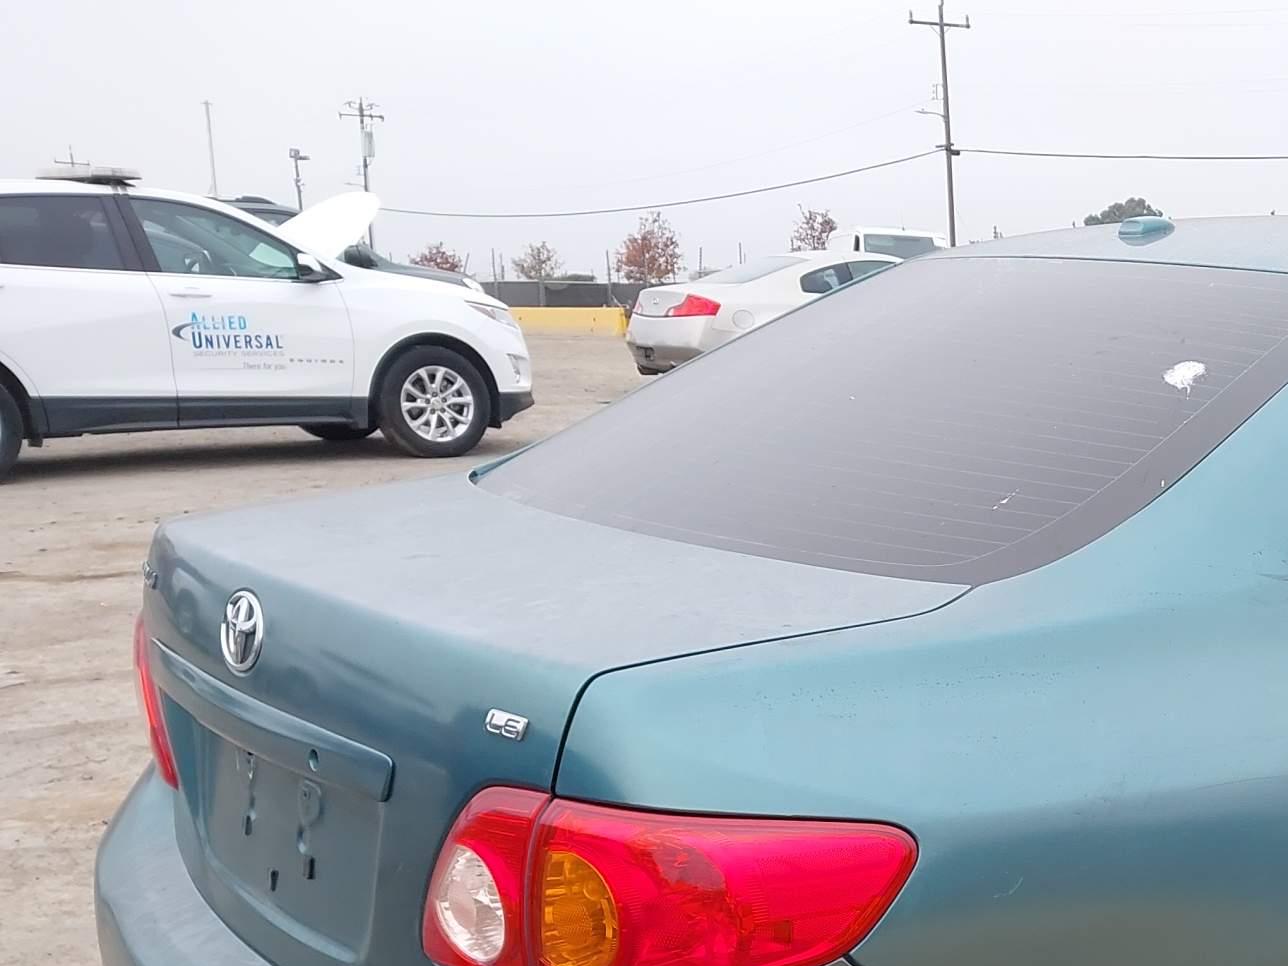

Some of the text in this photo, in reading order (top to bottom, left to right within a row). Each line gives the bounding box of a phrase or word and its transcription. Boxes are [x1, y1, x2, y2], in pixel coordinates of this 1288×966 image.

[190, 312, 248, 330] ALLIED
[191, 331, 284, 349] UNIVERSAL
[487, 712, 522, 739] LE
